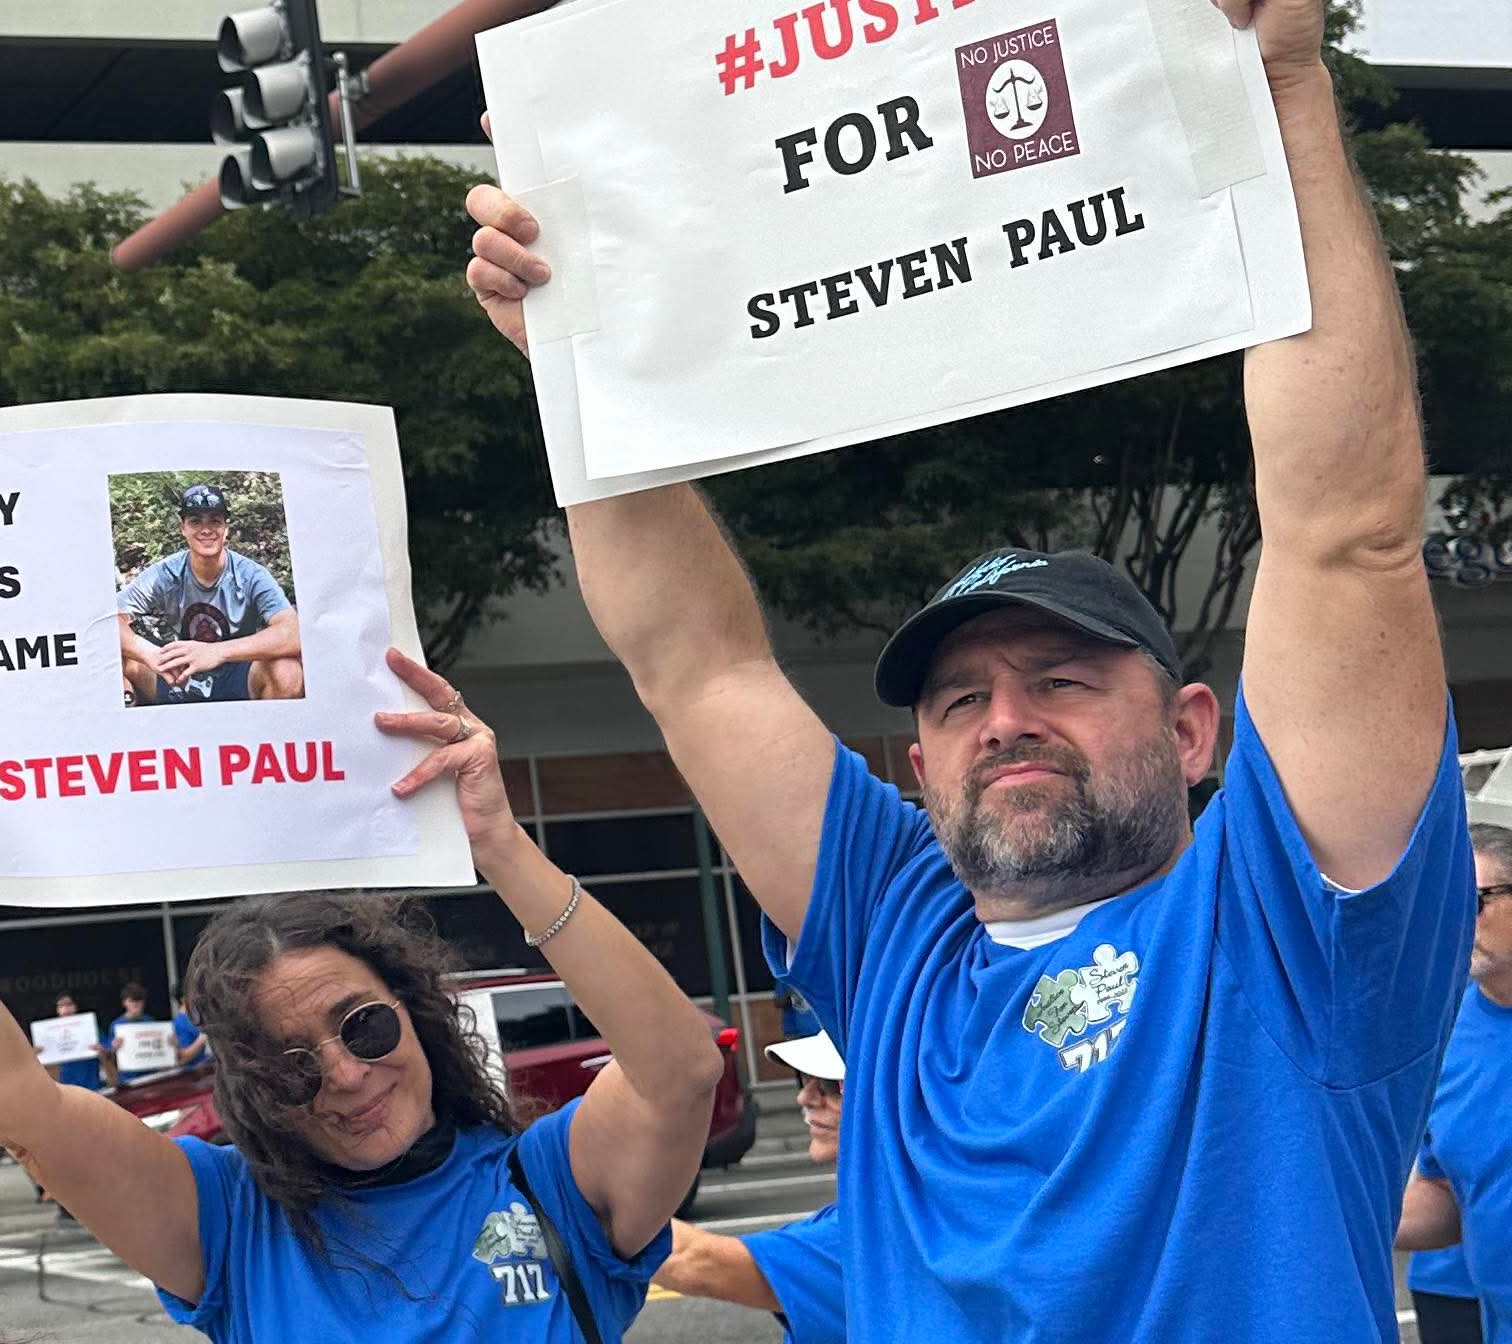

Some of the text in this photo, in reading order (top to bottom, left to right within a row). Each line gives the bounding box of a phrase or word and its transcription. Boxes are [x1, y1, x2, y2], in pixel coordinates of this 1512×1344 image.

[960, 25, 1055, 69] NO JUSTICE
[774, 96, 934, 195] FOR
[974, 131, 1075, 173] NO PEACE
[748, 186, 1145, 339] STEVEN PAUL
[218, 741, 345, 786] PAUL
[492, 1263, 552, 1304] 717
